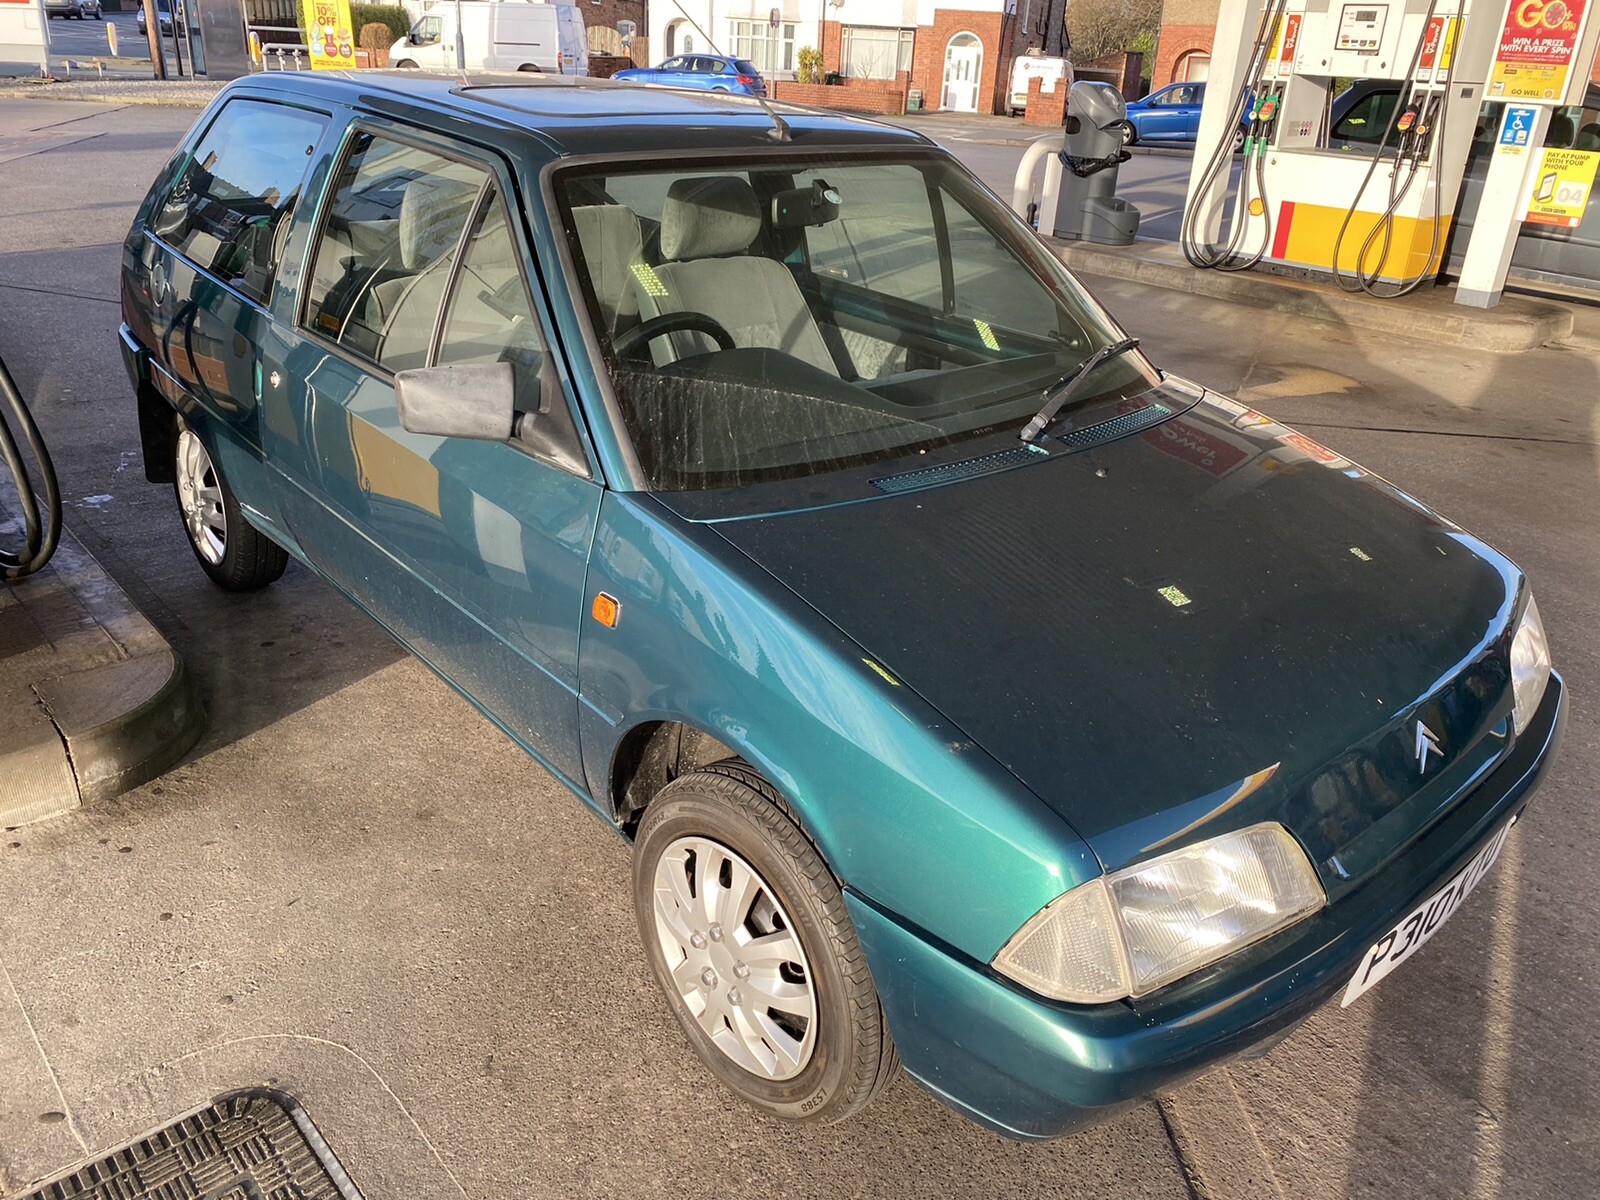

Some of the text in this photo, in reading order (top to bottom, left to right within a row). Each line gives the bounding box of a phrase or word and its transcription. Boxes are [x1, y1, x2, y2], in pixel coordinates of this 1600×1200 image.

[316, 6, 337, 16] 10%
[318, 16, 336, 26] OFF
[1513, 37, 1565, 47] WIN A PRIZE
[1500, 44, 1522, 52] WITH
[1524, 45, 1549, 53] EVERY
[1557, 187, 1583, 204] 04
[1361, 886, 1455, 986] P310
[801, 1087, 828, 1113] LS388
